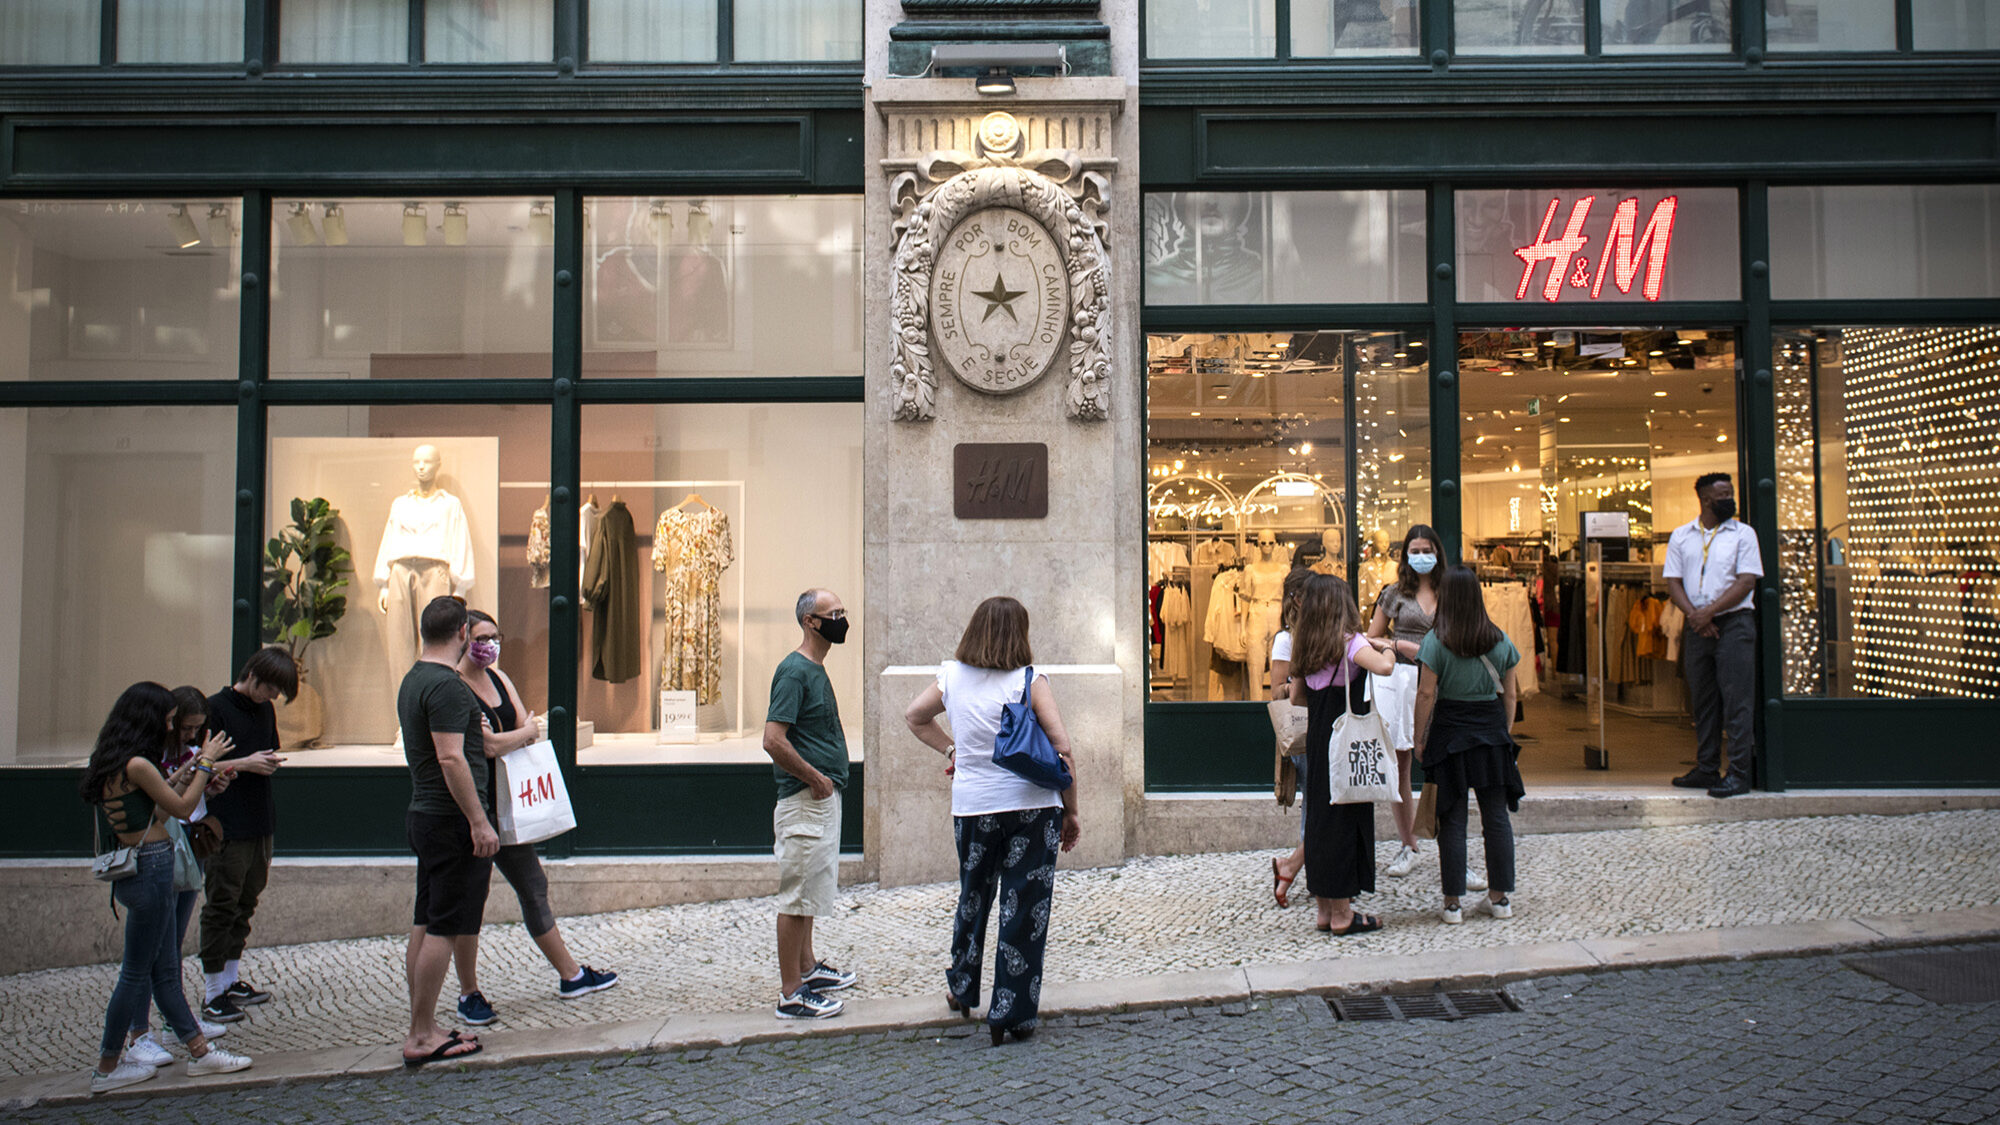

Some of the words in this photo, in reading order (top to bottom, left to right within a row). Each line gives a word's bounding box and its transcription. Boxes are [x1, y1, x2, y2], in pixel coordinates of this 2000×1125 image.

[955, 223, 984, 252] POR
[1007, 218, 1042, 249] BOM
[1514, 195, 1678, 301] H&M
[939, 270, 959, 340] SEMPRE
[1040, 263, 1060, 344] CAMINHO
[961, 356, 976, 371] E
[982, 356, 1039, 385] SEGUE
[967, 457, 1034, 504] H&M
[1349, 738, 1383, 753] CASA
[518, 772, 556, 808] H&M
